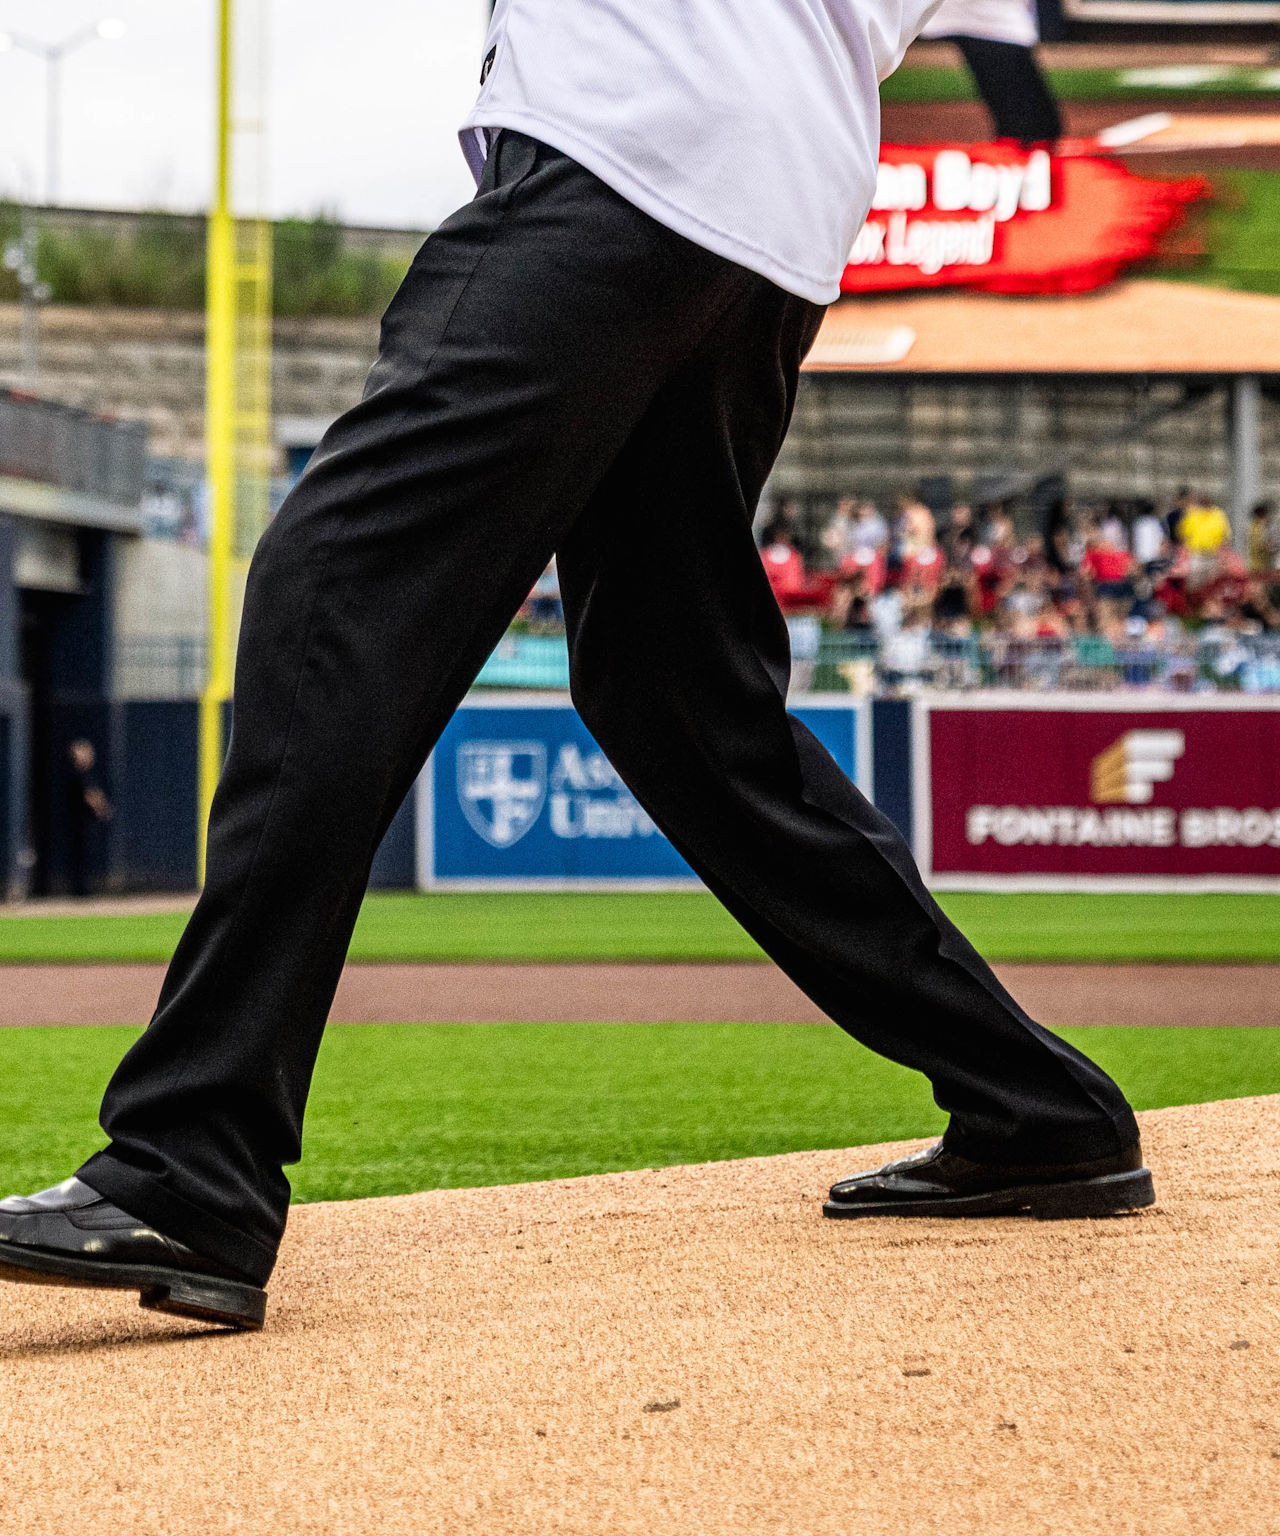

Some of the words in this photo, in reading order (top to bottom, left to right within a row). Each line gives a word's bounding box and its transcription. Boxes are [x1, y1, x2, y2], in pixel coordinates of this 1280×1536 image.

[933, 149, 1052, 223] Boyd
[885, 210, 997, 276] Legend
[964, 804, 1177, 848] FONTAINE
